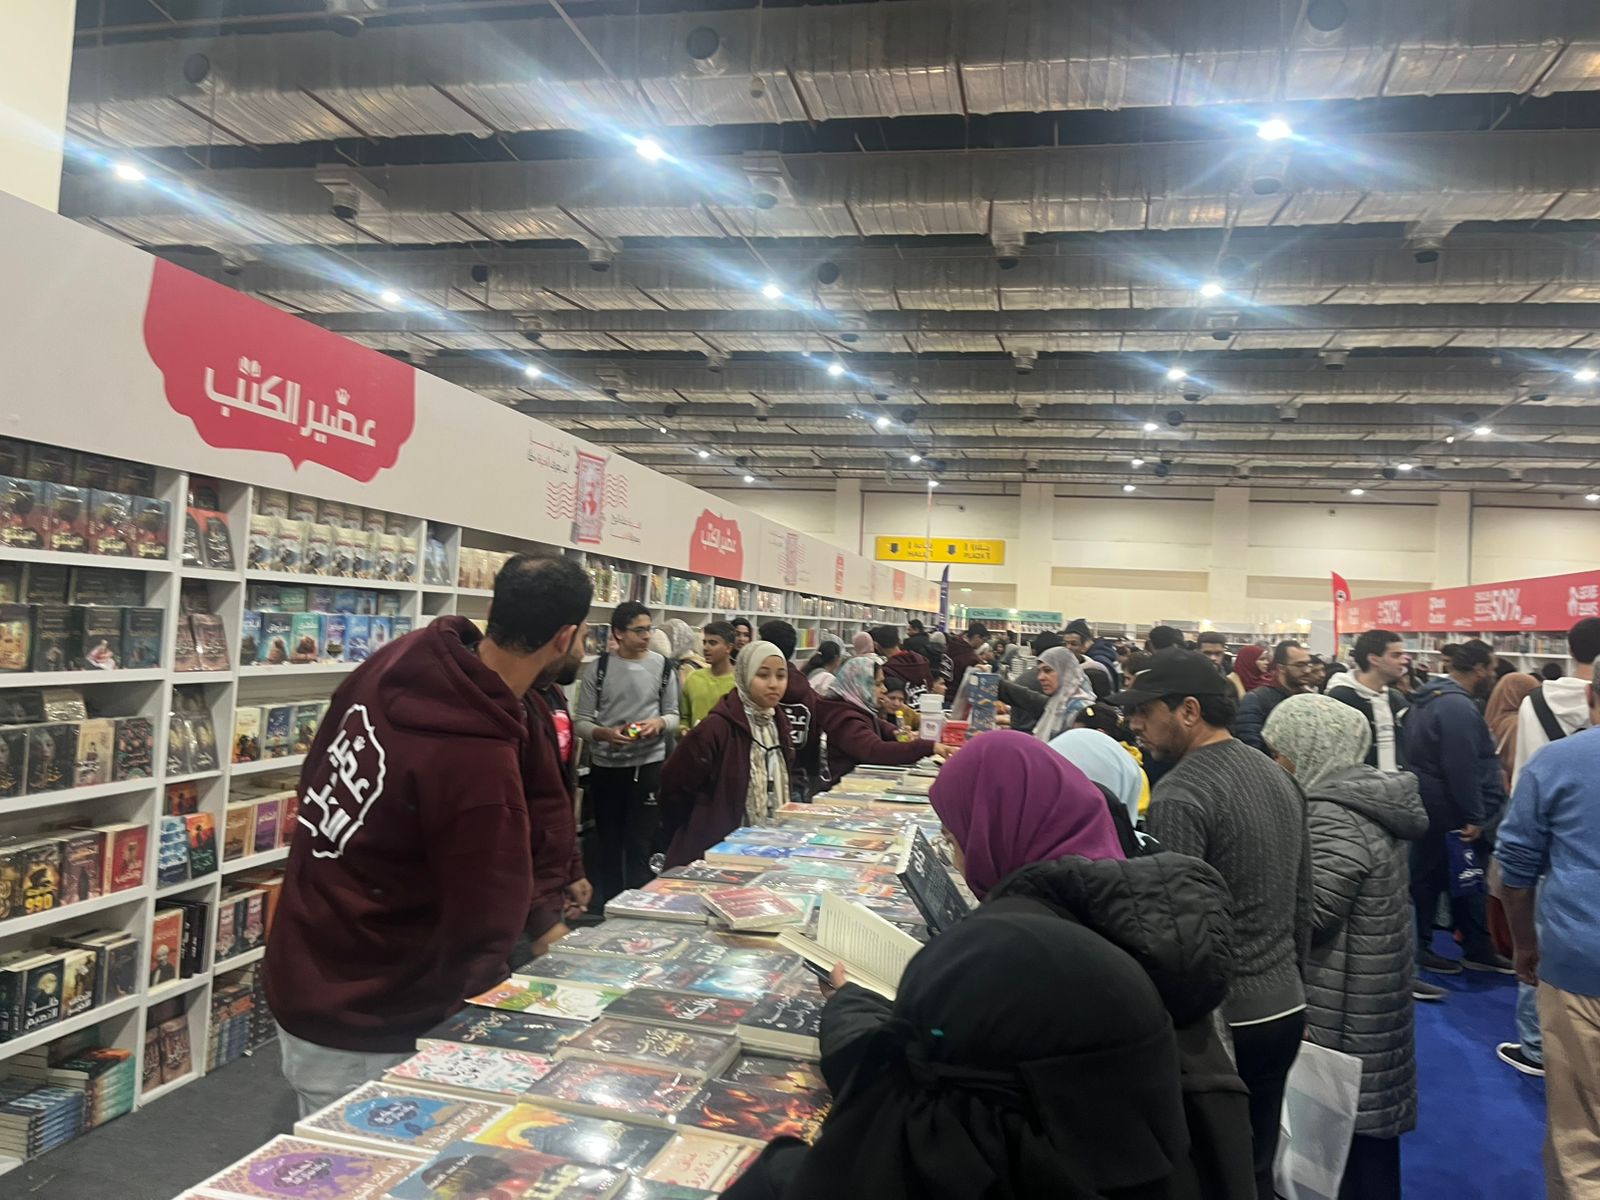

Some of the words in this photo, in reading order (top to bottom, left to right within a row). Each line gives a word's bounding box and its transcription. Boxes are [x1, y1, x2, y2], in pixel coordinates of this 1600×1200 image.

[204, 356, 301, 425] الكتب
[300, 388, 376, 447] عصير
[1491, 588, 1522, 622] 50%
